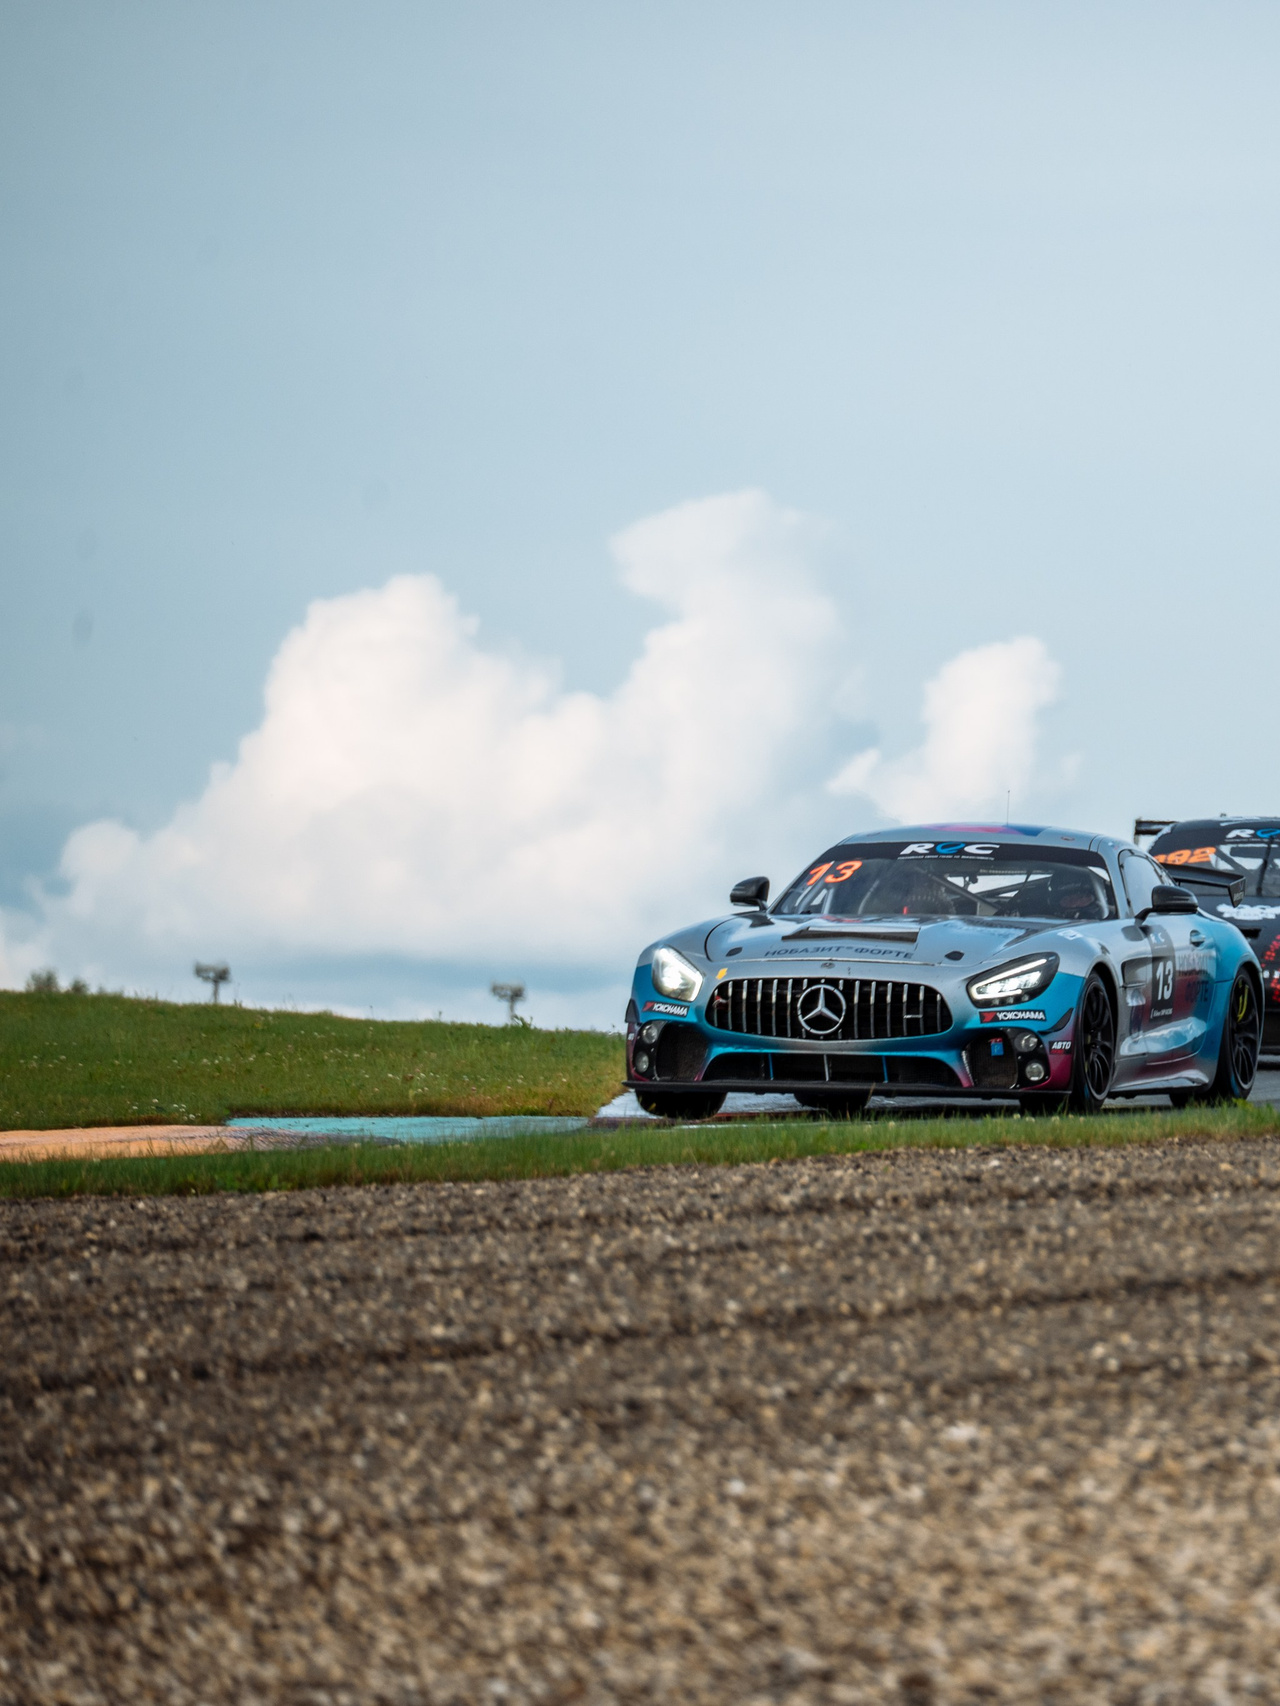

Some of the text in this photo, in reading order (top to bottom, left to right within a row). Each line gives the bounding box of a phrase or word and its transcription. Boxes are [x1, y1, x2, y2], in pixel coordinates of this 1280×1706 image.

[806, 860, 863, 886] 13
[854, 946, 915, 959] ФОРТЕ
[1156, 960, 1173, 1001] 13
[653, 1003, 688, 1017] YOKOHAMA
[996, 1011, 1046, 1021] YOKOHAMA
